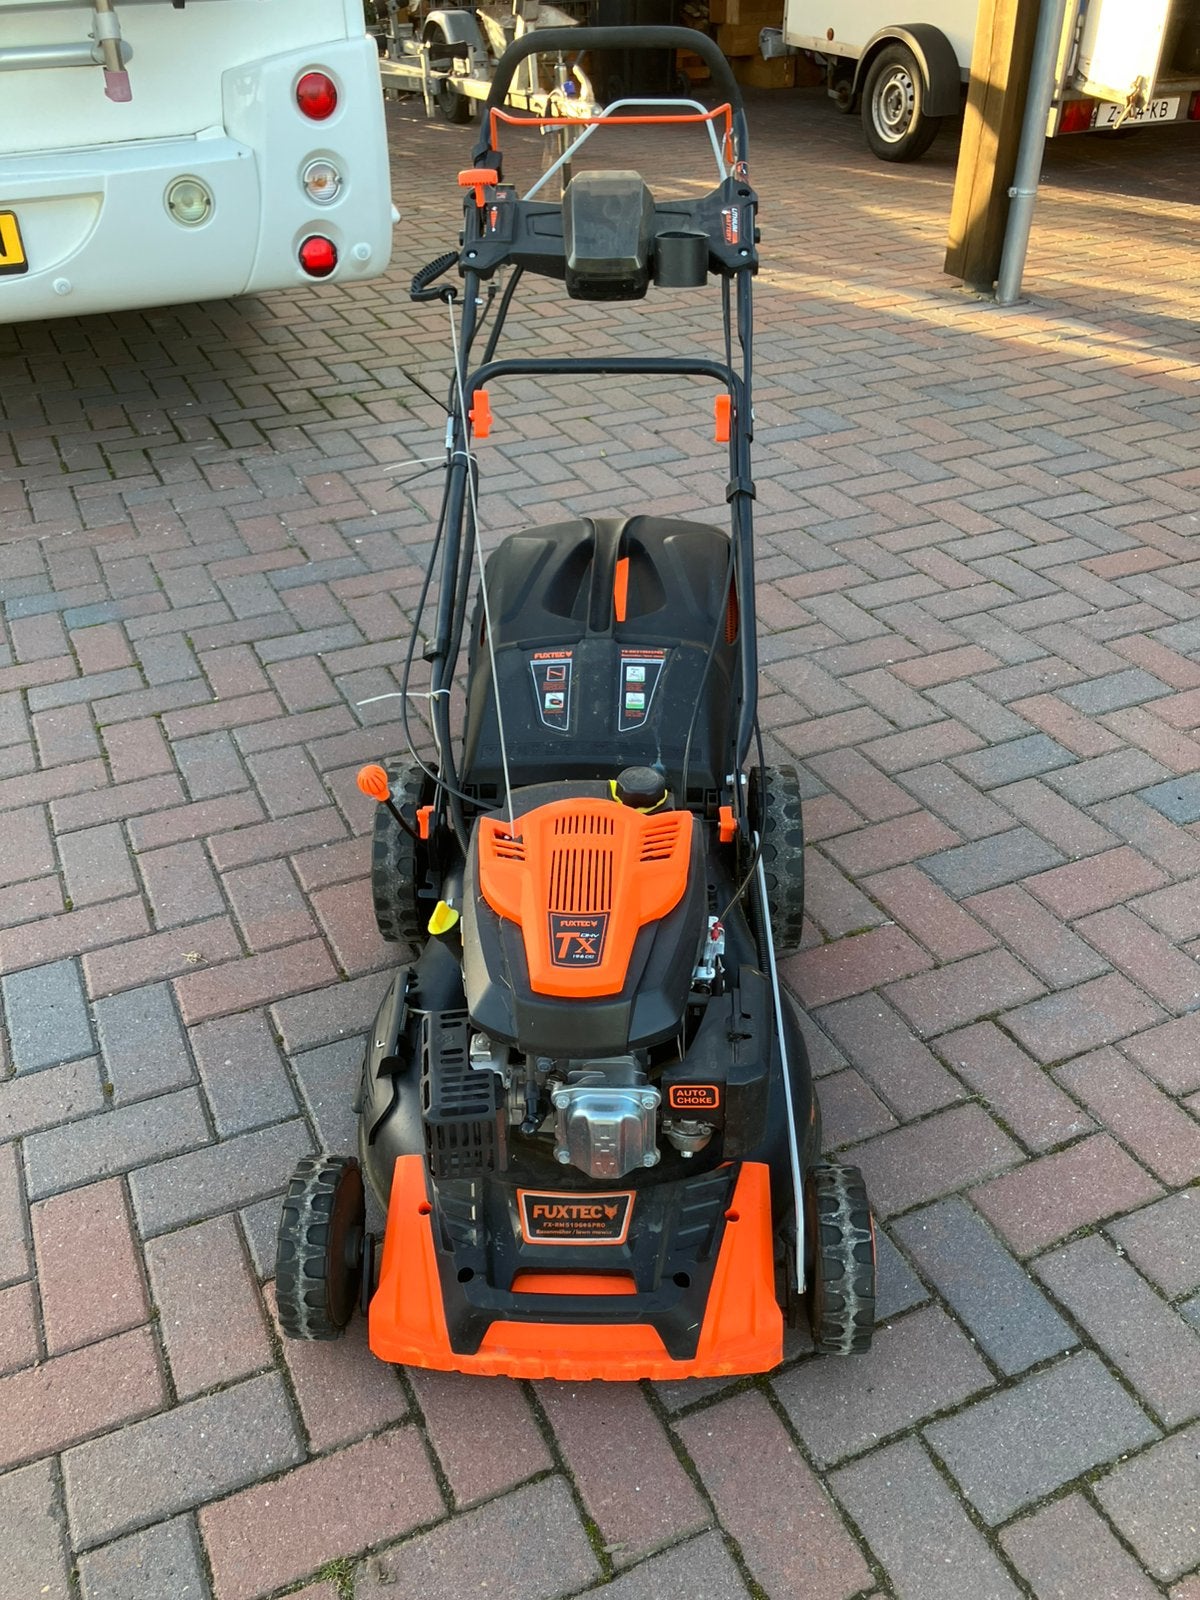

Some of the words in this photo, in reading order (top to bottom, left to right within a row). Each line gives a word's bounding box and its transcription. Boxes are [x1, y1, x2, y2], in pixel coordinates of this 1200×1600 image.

[533, 651, 565, 659] FUXTEC
[676, 1089, 707, 1097] AUTO
[533, 1204, 602, 1219] FUXTEC
